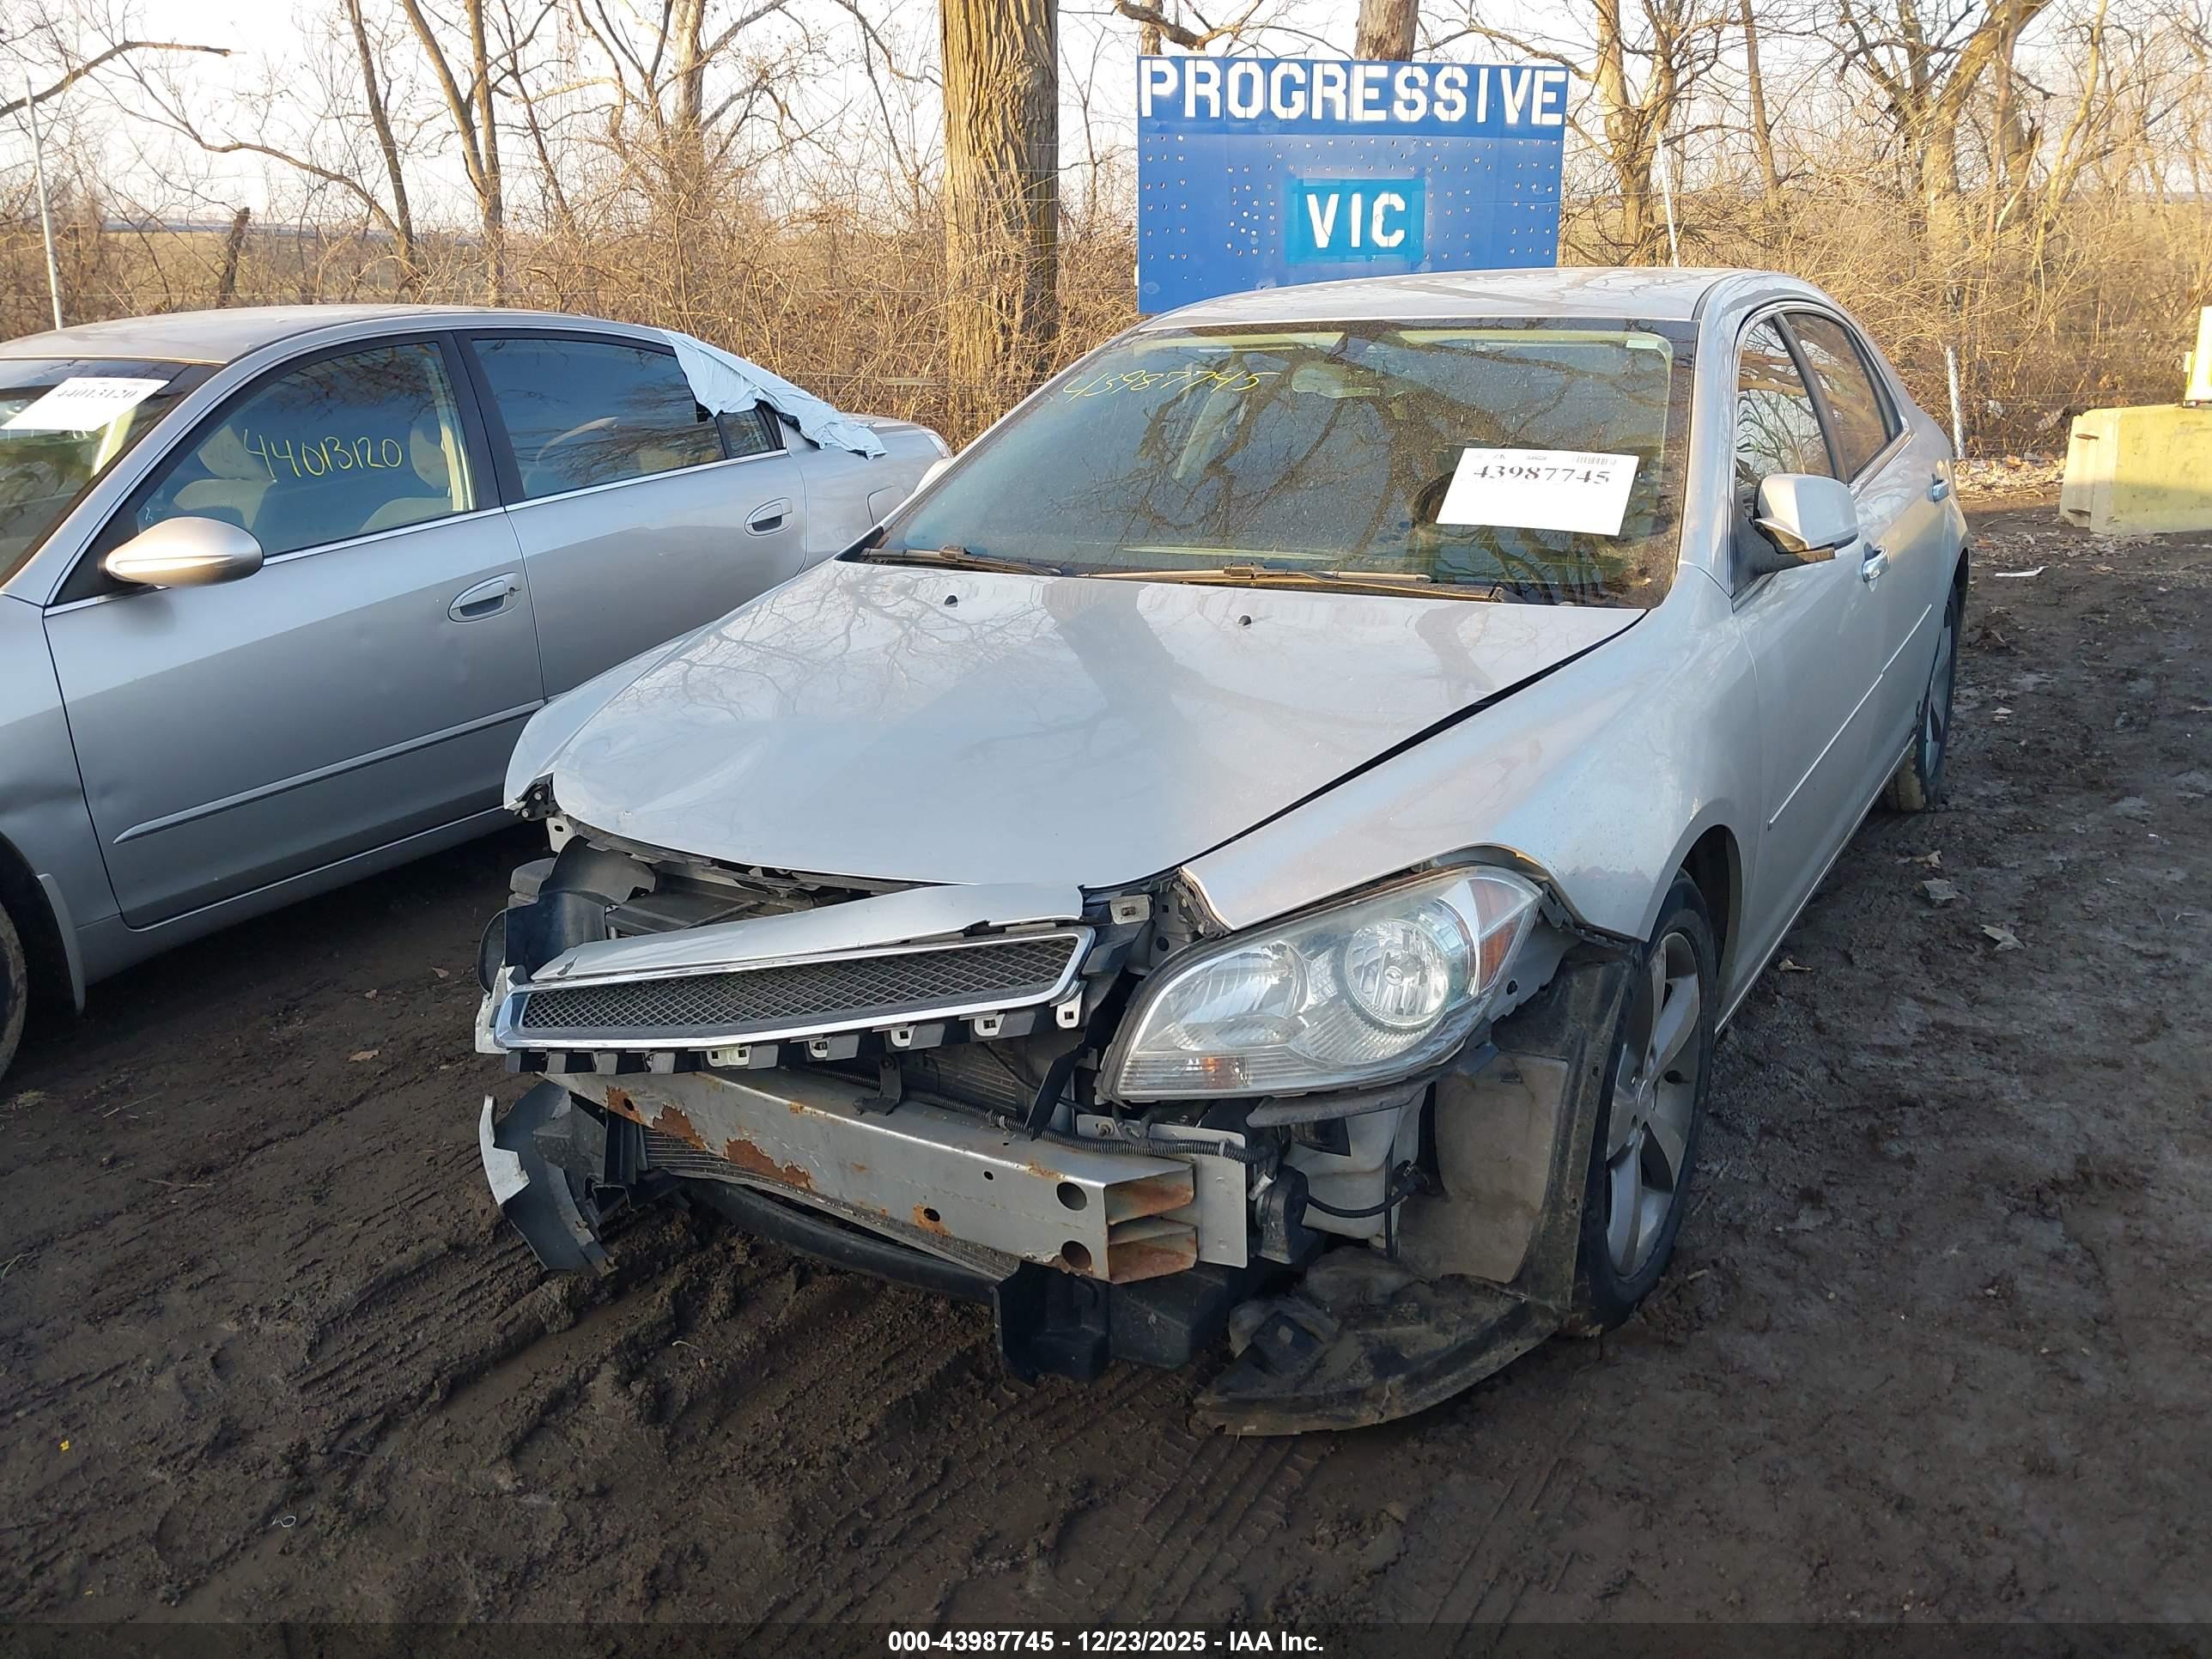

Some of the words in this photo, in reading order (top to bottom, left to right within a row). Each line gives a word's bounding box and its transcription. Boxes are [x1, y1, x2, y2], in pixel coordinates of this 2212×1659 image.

[1140, 59, 1566, 125] PROGRESSIVE
[1306, 192, 1406, 248] VIC
[1063, 370, 1281, 404] 43987745
[244, 428, 403, 479] 44013120
[1474, 465, 1611, 484] 43987745
